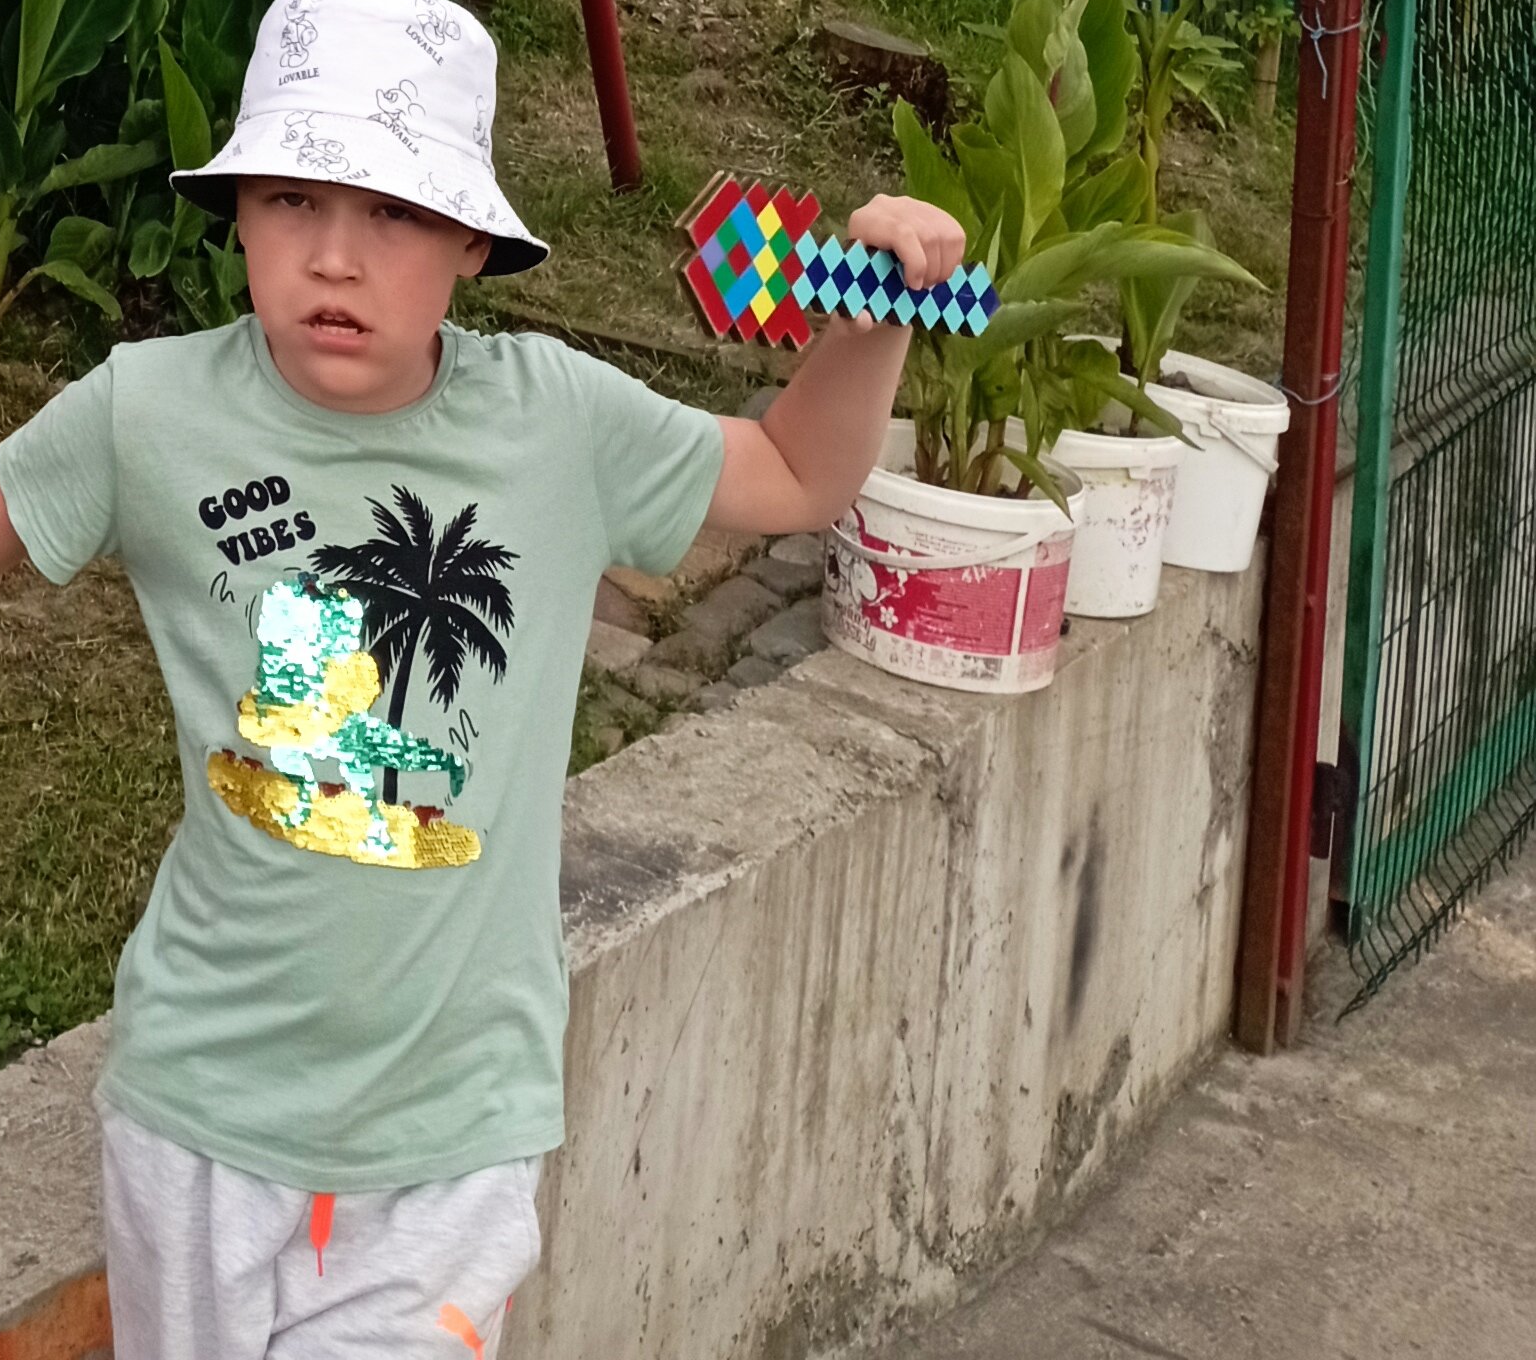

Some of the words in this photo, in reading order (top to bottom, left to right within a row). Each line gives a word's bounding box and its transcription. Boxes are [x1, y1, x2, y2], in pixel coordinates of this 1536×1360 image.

[405, 25, 444, 66] LOVABLE
[278, 67, 320, 86] LOVABLE
[198, 475, 291, 530] GOOD
[216, 510, 317, 566] VIBES
